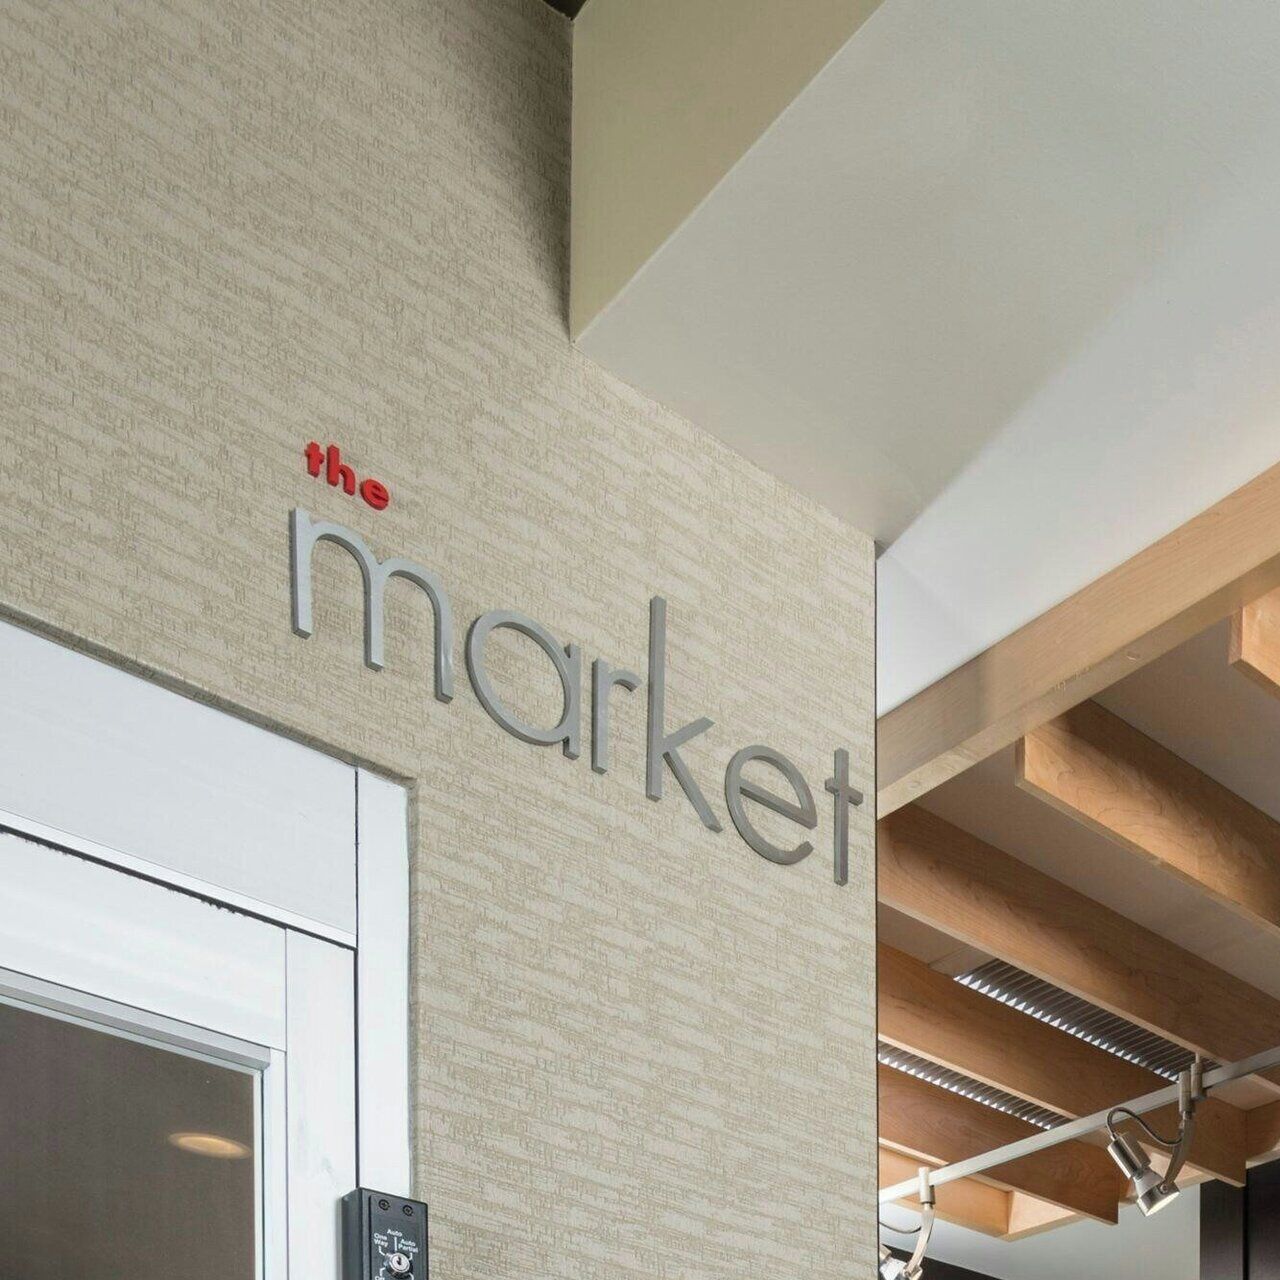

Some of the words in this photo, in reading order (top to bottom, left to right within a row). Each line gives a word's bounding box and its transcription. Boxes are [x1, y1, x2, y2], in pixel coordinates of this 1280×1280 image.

[303, 441, 390, 511] the
[290, 506, 864, 886] market
[387, 1229, 402, 1237] Auto
[374, 1239, 389, 1247] Way
[401, 1239, 416, 1247] Auto
[398, 1243, 419, 1253] Partial
